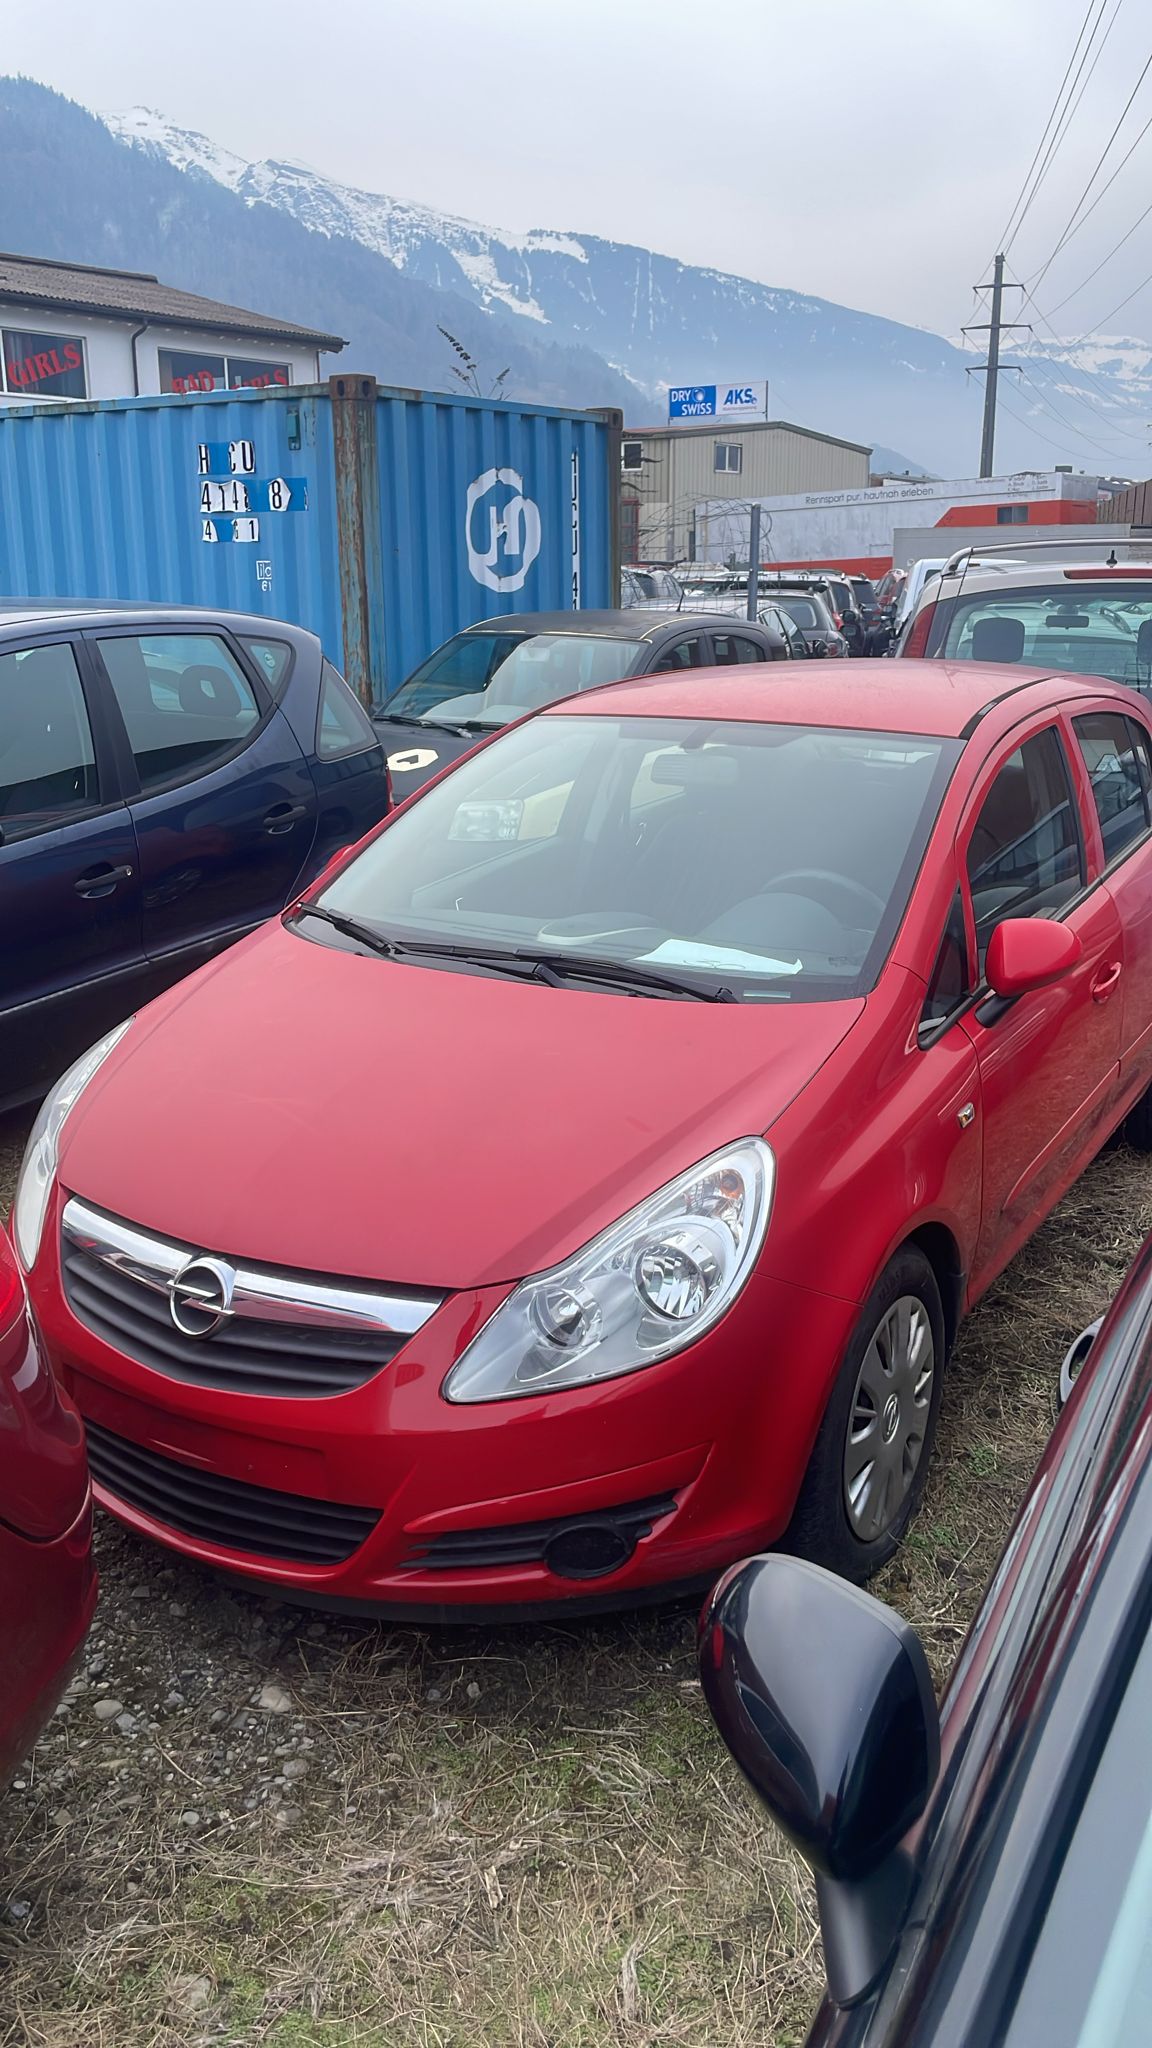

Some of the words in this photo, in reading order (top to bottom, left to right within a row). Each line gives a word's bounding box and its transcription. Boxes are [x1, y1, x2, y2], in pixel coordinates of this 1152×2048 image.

[8, 342, 81, 387] GIRLS
[172, 370, 215, 394] BAD
[671, 390, 691, 402] DRY
[723, 388, 753, 405] AKS
[681, 403, 712, 416] SWISS
[805, 495, 844, 504] Rennsport
[901, 486, 934, 498] erleben
